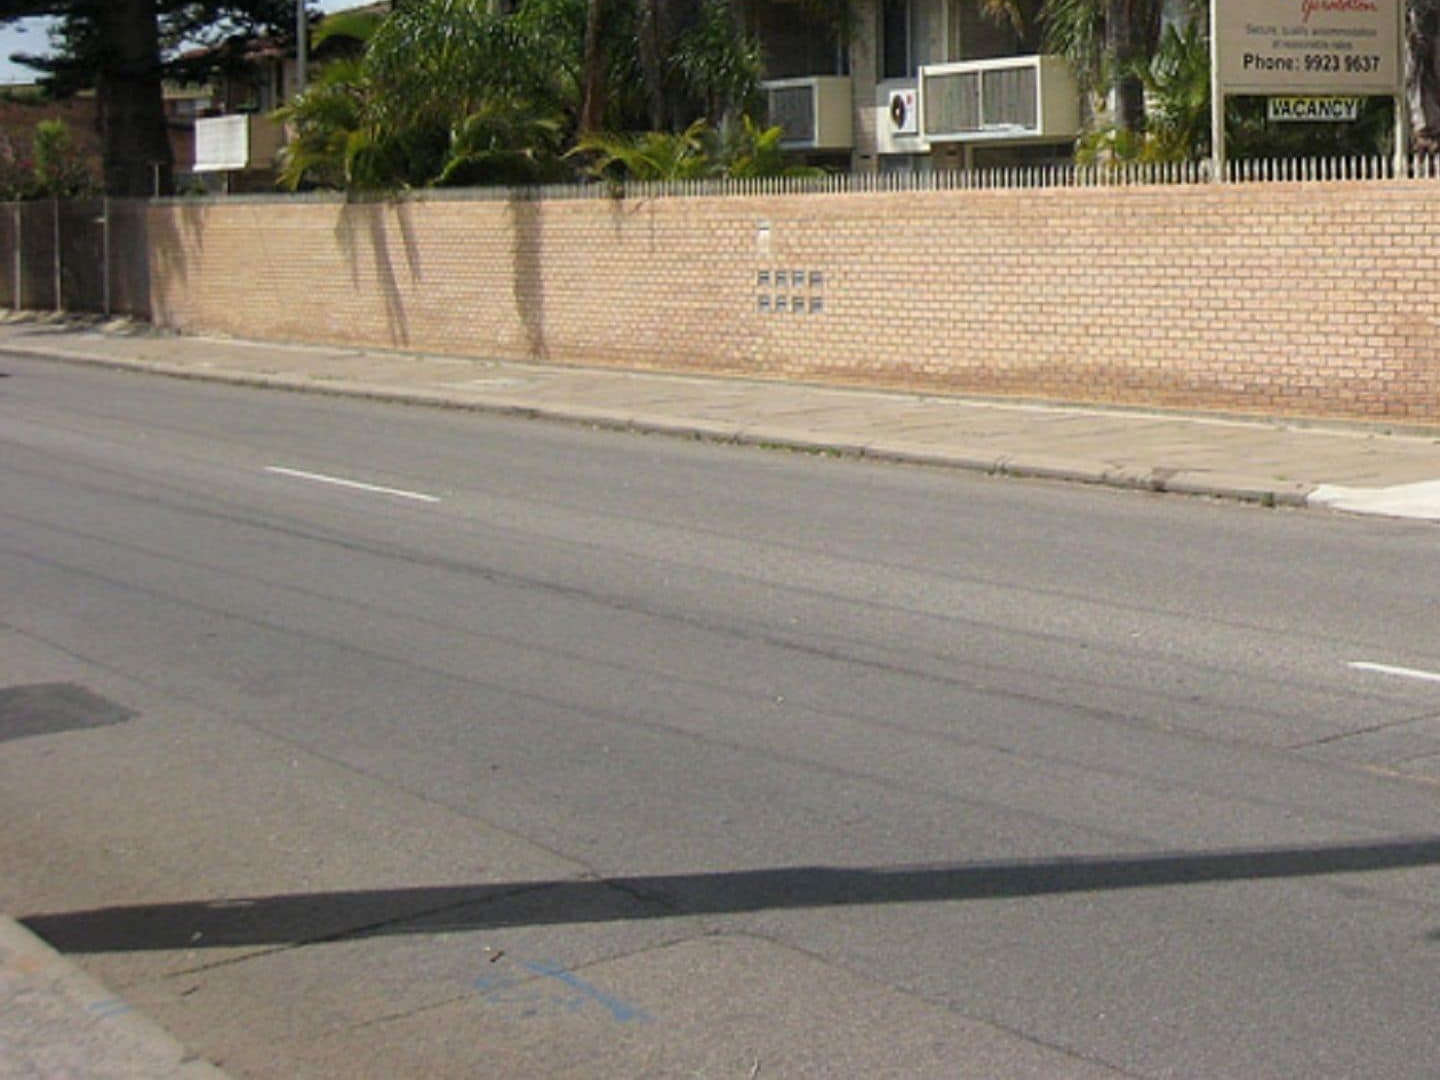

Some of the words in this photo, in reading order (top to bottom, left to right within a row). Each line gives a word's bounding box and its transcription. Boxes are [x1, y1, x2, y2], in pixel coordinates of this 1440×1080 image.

[1243, 53, 1300, 70] Phone:
[1304, 54, 1340, 72] 9923
[1344, 54, 1380, 72] 9637
[1272, 100, 1356, 117] VACANCY
